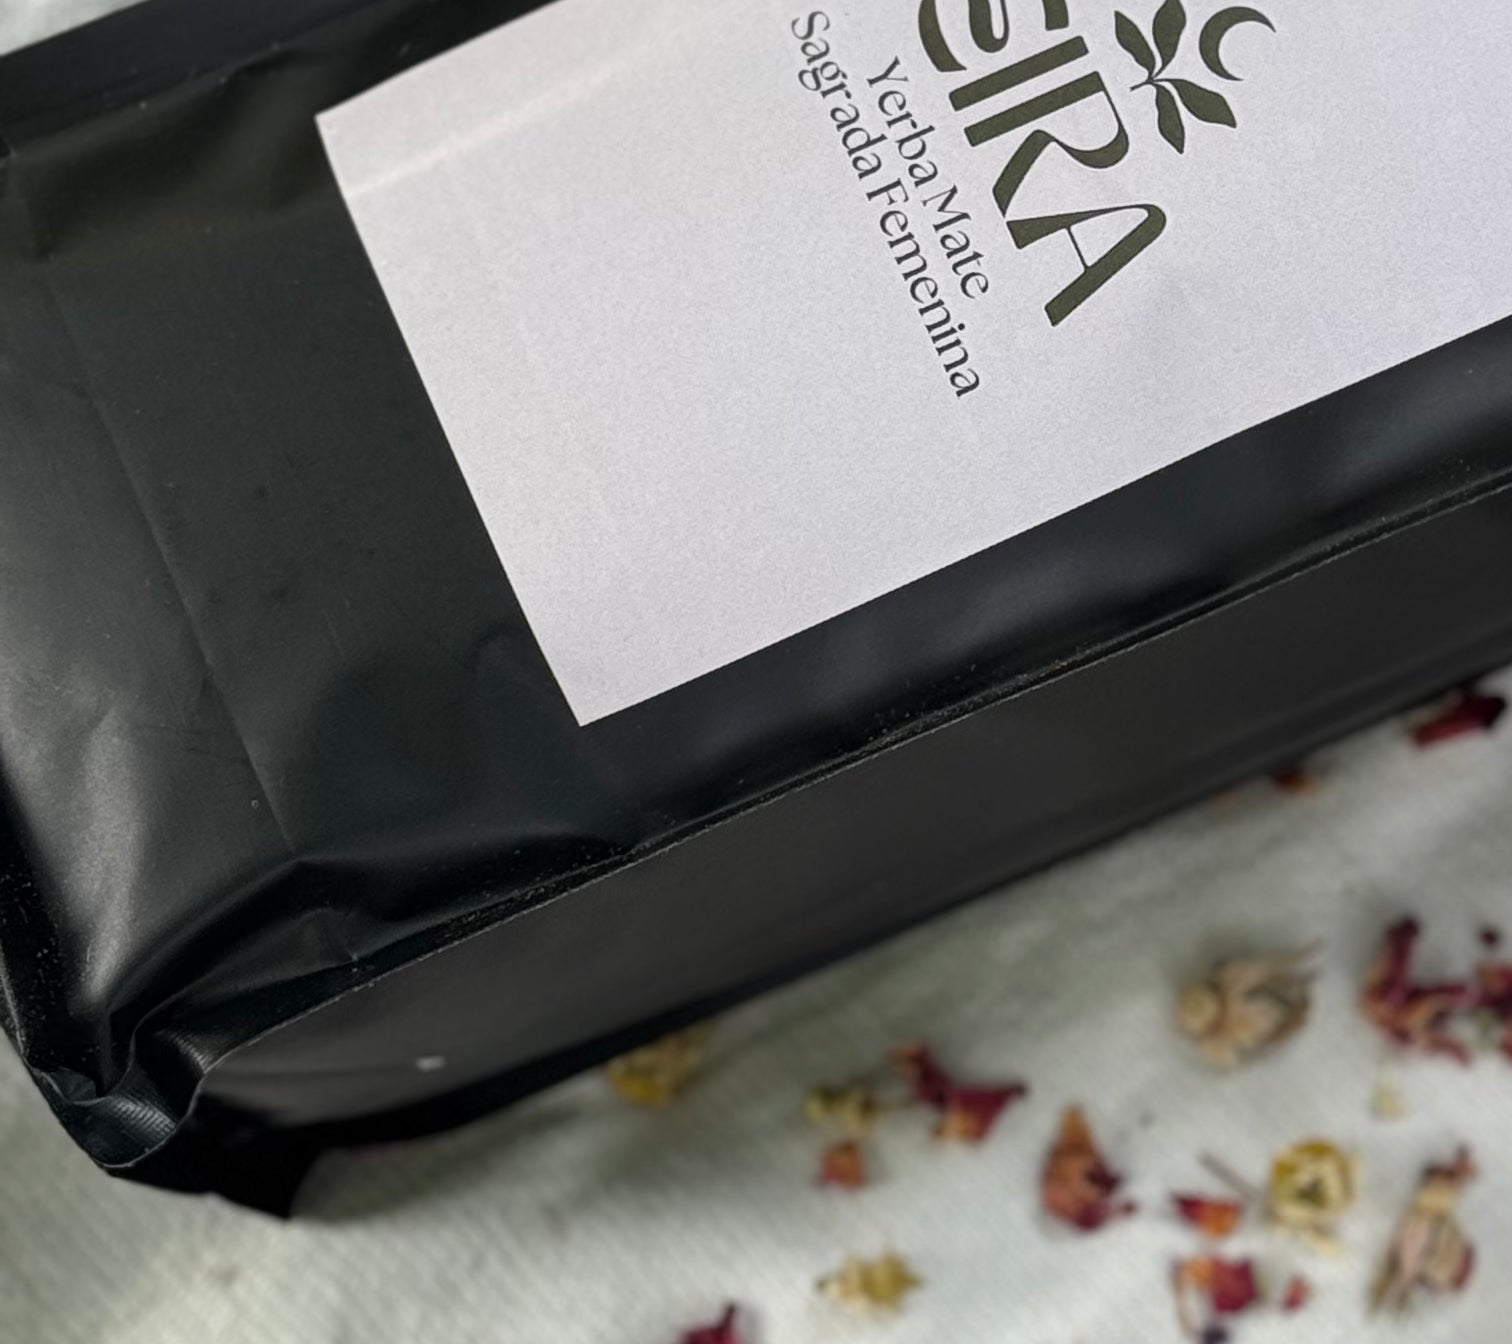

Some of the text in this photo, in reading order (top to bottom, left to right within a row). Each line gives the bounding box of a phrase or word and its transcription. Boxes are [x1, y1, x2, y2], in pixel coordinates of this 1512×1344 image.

[792, 12, 979, 397] Sagrada Femenina
[867, 57, 988, 298] Yerba Mate
